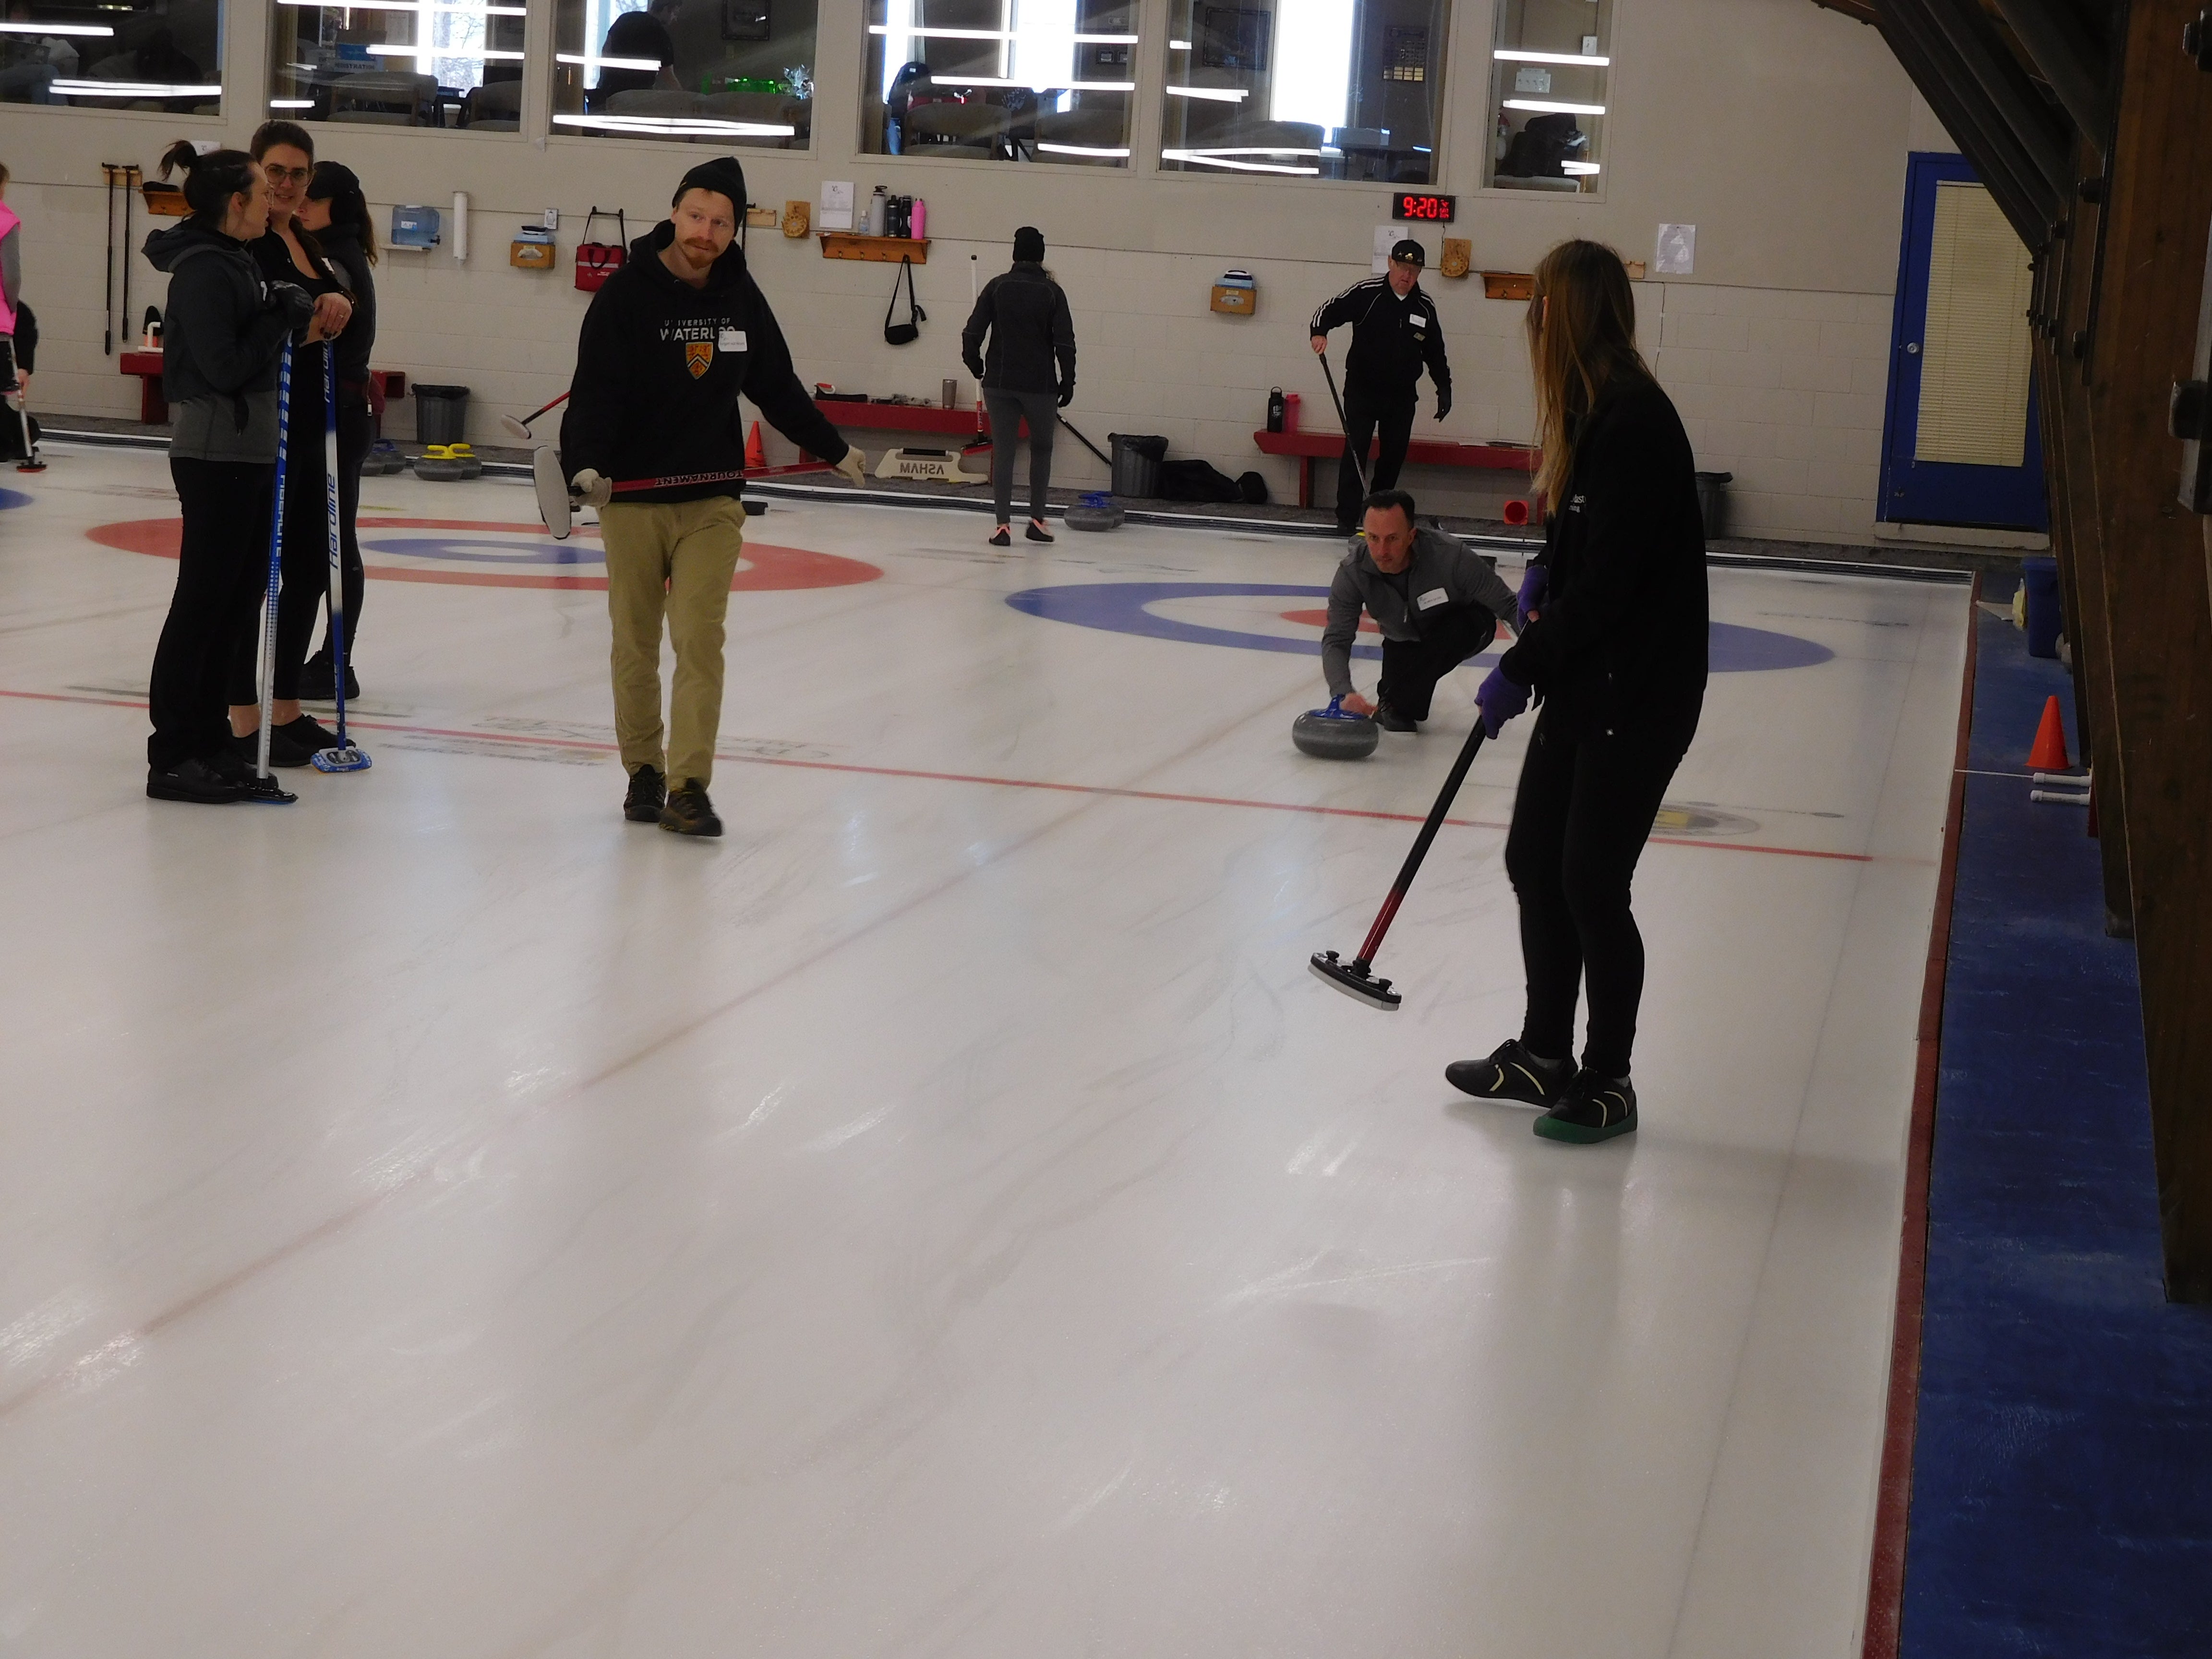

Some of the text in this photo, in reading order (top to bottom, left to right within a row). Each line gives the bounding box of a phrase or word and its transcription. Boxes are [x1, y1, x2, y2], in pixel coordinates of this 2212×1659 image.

[1403, 196, 1438, 218] 9:20
[664, 318, 717, 326] UIVERSITY
[655, 470, 744, 486] TOURNAMENT
[327, 473, 338, 570] Hardline
